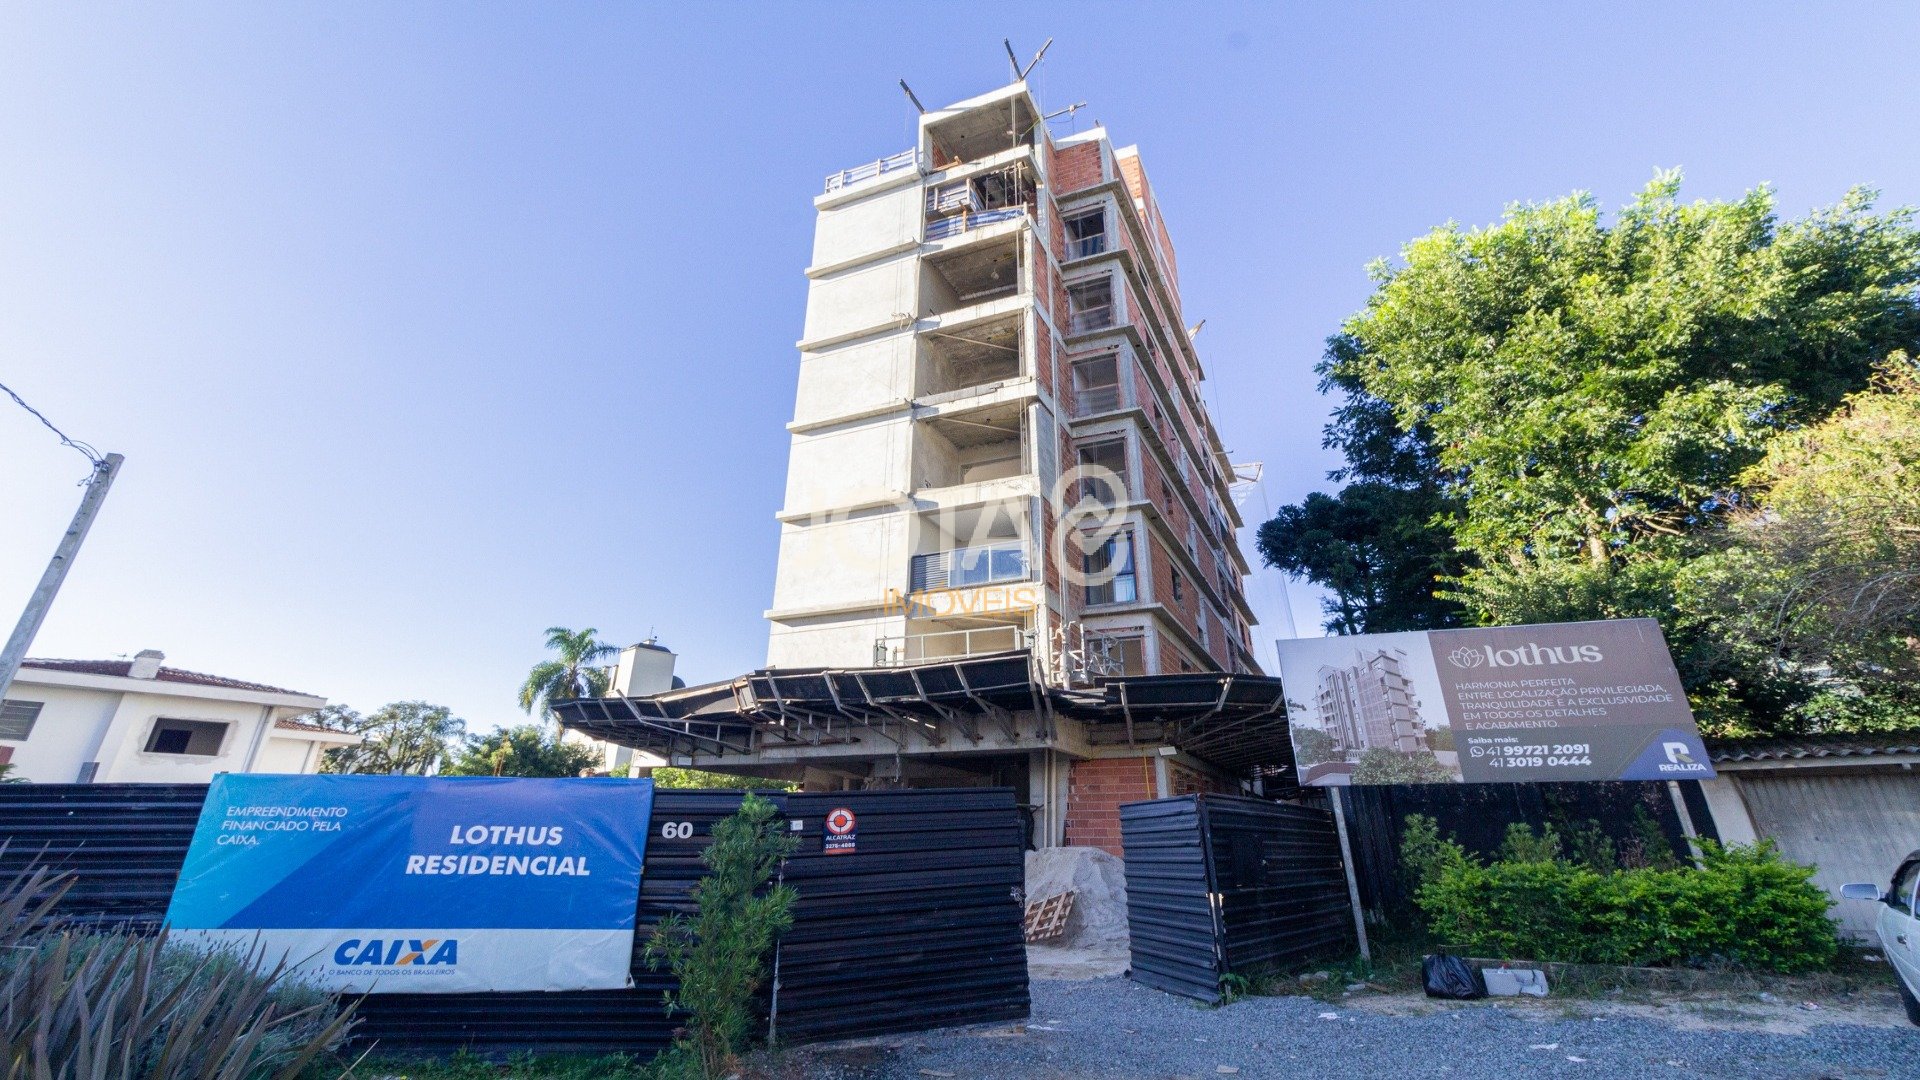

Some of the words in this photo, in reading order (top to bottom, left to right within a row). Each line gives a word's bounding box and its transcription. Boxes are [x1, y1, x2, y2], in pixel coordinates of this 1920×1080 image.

[1484, 642, 1603, 668] lothus
[1455, 680, 1519, 690] HARMONIA
[1520, 678, 1576, 688] PERFEITA
[1457, 691, 1495, 701] ENTRE
[1497, 687, 1578, 699] LOCALIZAÇÃO
[1579, 684, 1667, 696] PRIVILEGIADA,
[1459, 699, 1555, 710] TRANQUILIDADE
[1557, 698, 1565, 707] E
[1567, 698, 1577, 706] A
[1578, 693, 1675, 706] EXCLUSIVIDADE
[1462, 711, 1481, 721] EM
[1482, 710, 1524, 720] TODOS
[1525, 709, 1543, 719] OS
[1544, 707, 1607, 718] DETALHES
[1465, 722, 1474, 731] E
[1475, 719, 1560, 730] ACABAMENTO.
[1467, 737, 1493, 745] Saiba
[1494, 736, 1519, 744] mais:
[1486, 746, 1501, 756] 41
[1503, 744, 1549, 756] 99721
[1552, 743, 1591, 755] 2091
[1489, 757, 1504, 768] 41
[1506, 756, 1543, 768] 3019
[1547, 755, 1593, 767] 0444
[1658, 763, 1708, 772] REALIZA
[226, 806, 348, 818] EMPREENDIMENTO
[221, 820, 309, 832] FINANCIADO
[311, 821, 342, 832] PELA
[661, 821, 694, 839] 60
[216, 834, 261, 846] CAIXA.
[450, 825, 564, 846] LOTHUS
[405, 855, 591, 876] RESIDENCIAL
[334, 938, 458, 966] CAIXA
[413, 968, 456, 976] BRASILEIROS
